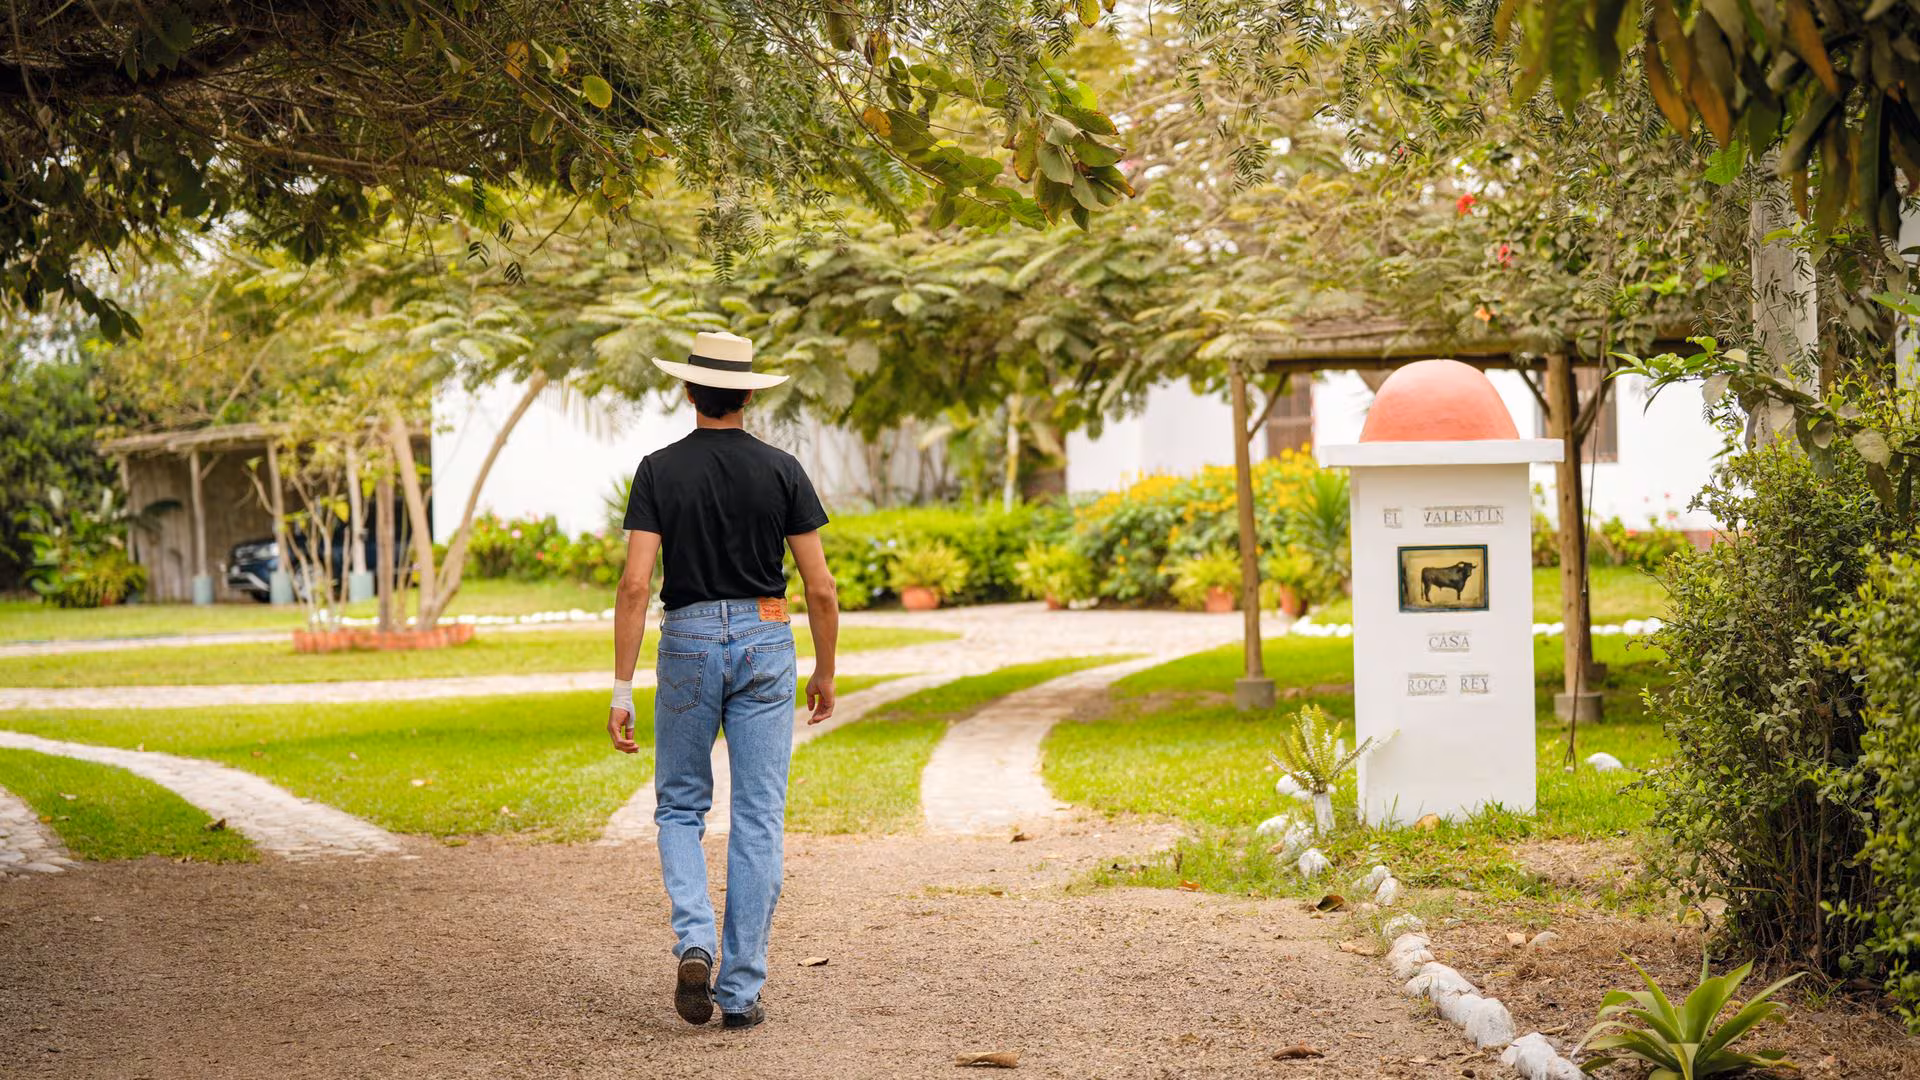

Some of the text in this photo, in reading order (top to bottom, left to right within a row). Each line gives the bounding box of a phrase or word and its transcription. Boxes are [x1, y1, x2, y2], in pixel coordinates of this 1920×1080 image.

[1384, 511, 1400, 525] EL
[1429, 635, 1469, 649] CASA
[1408, 678, 1488, 692] ROCA REY
